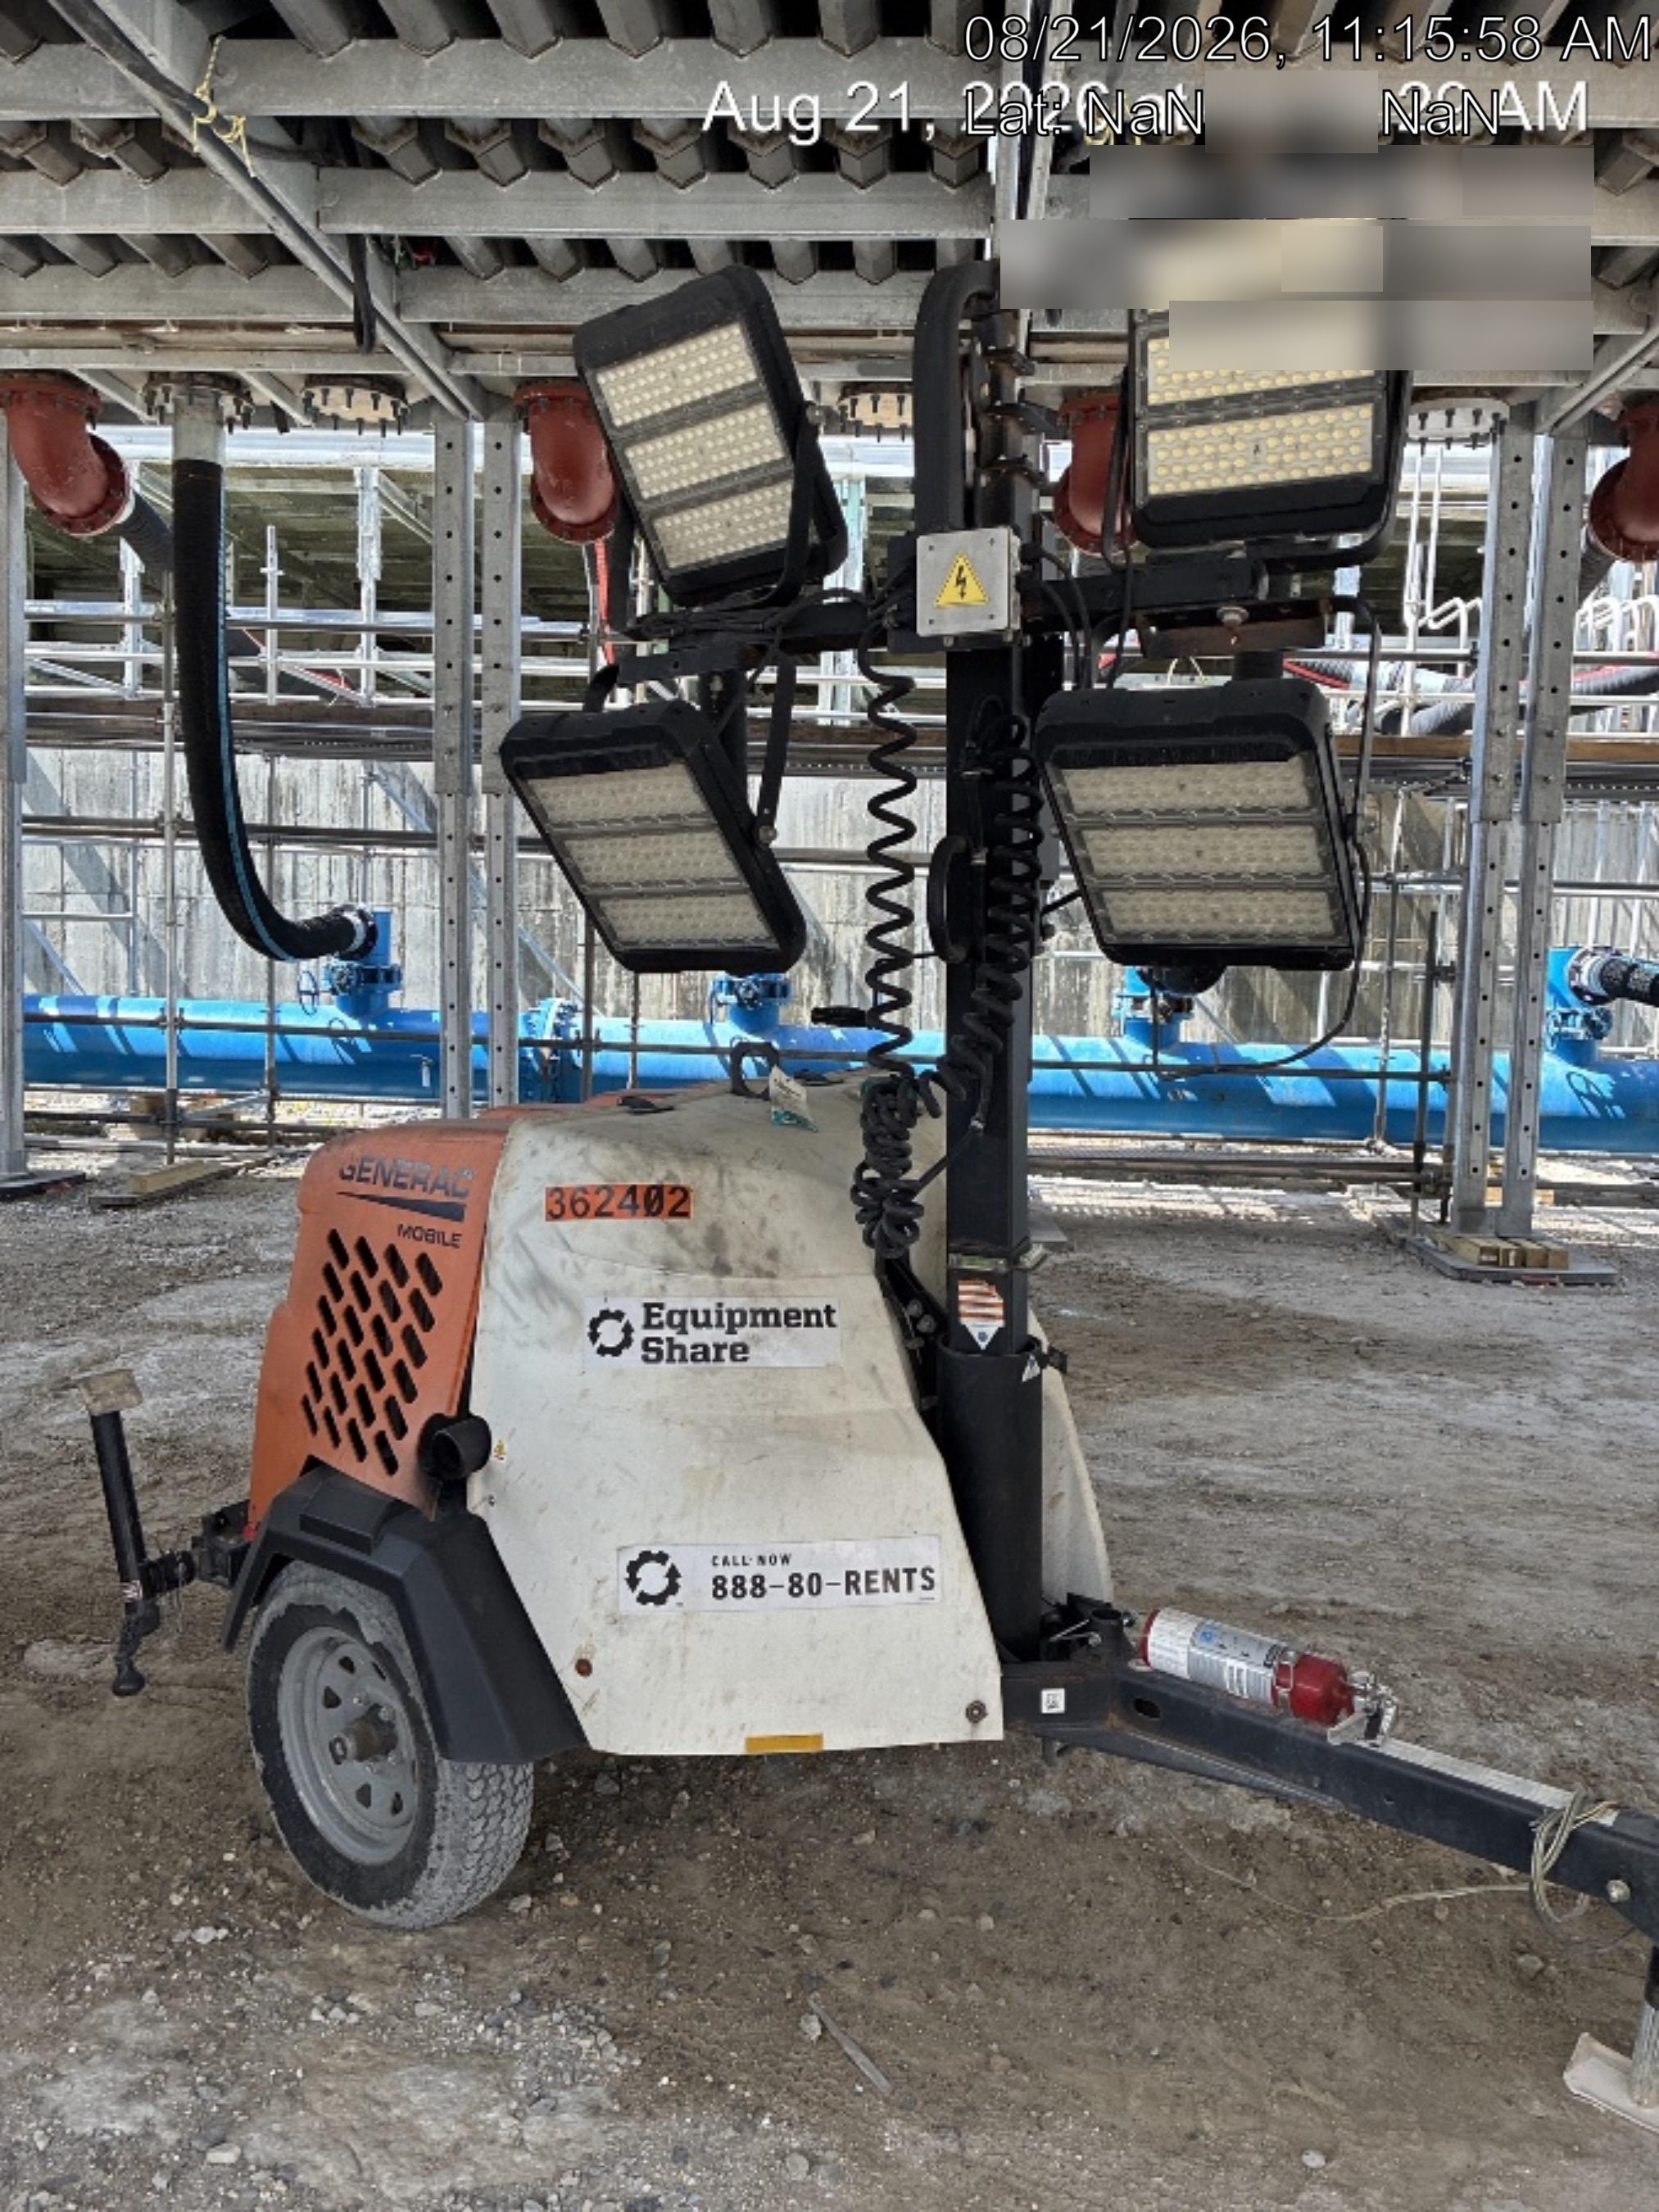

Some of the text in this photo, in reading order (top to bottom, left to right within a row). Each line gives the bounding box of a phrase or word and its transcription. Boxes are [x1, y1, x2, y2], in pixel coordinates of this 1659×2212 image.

[339, 1154, 474, 1199] GENERAC
[547, 1184, 690, 1219] 362402
[397, 1223, 462, 1249] MOBILE
[642, 1302, 837, 1335] Equipment
[641, 1336, 750, 1364] Share
[756, 1553, 791, 1566] NOW
[711, 1566, 936, 1600] 888-80-RENTS
